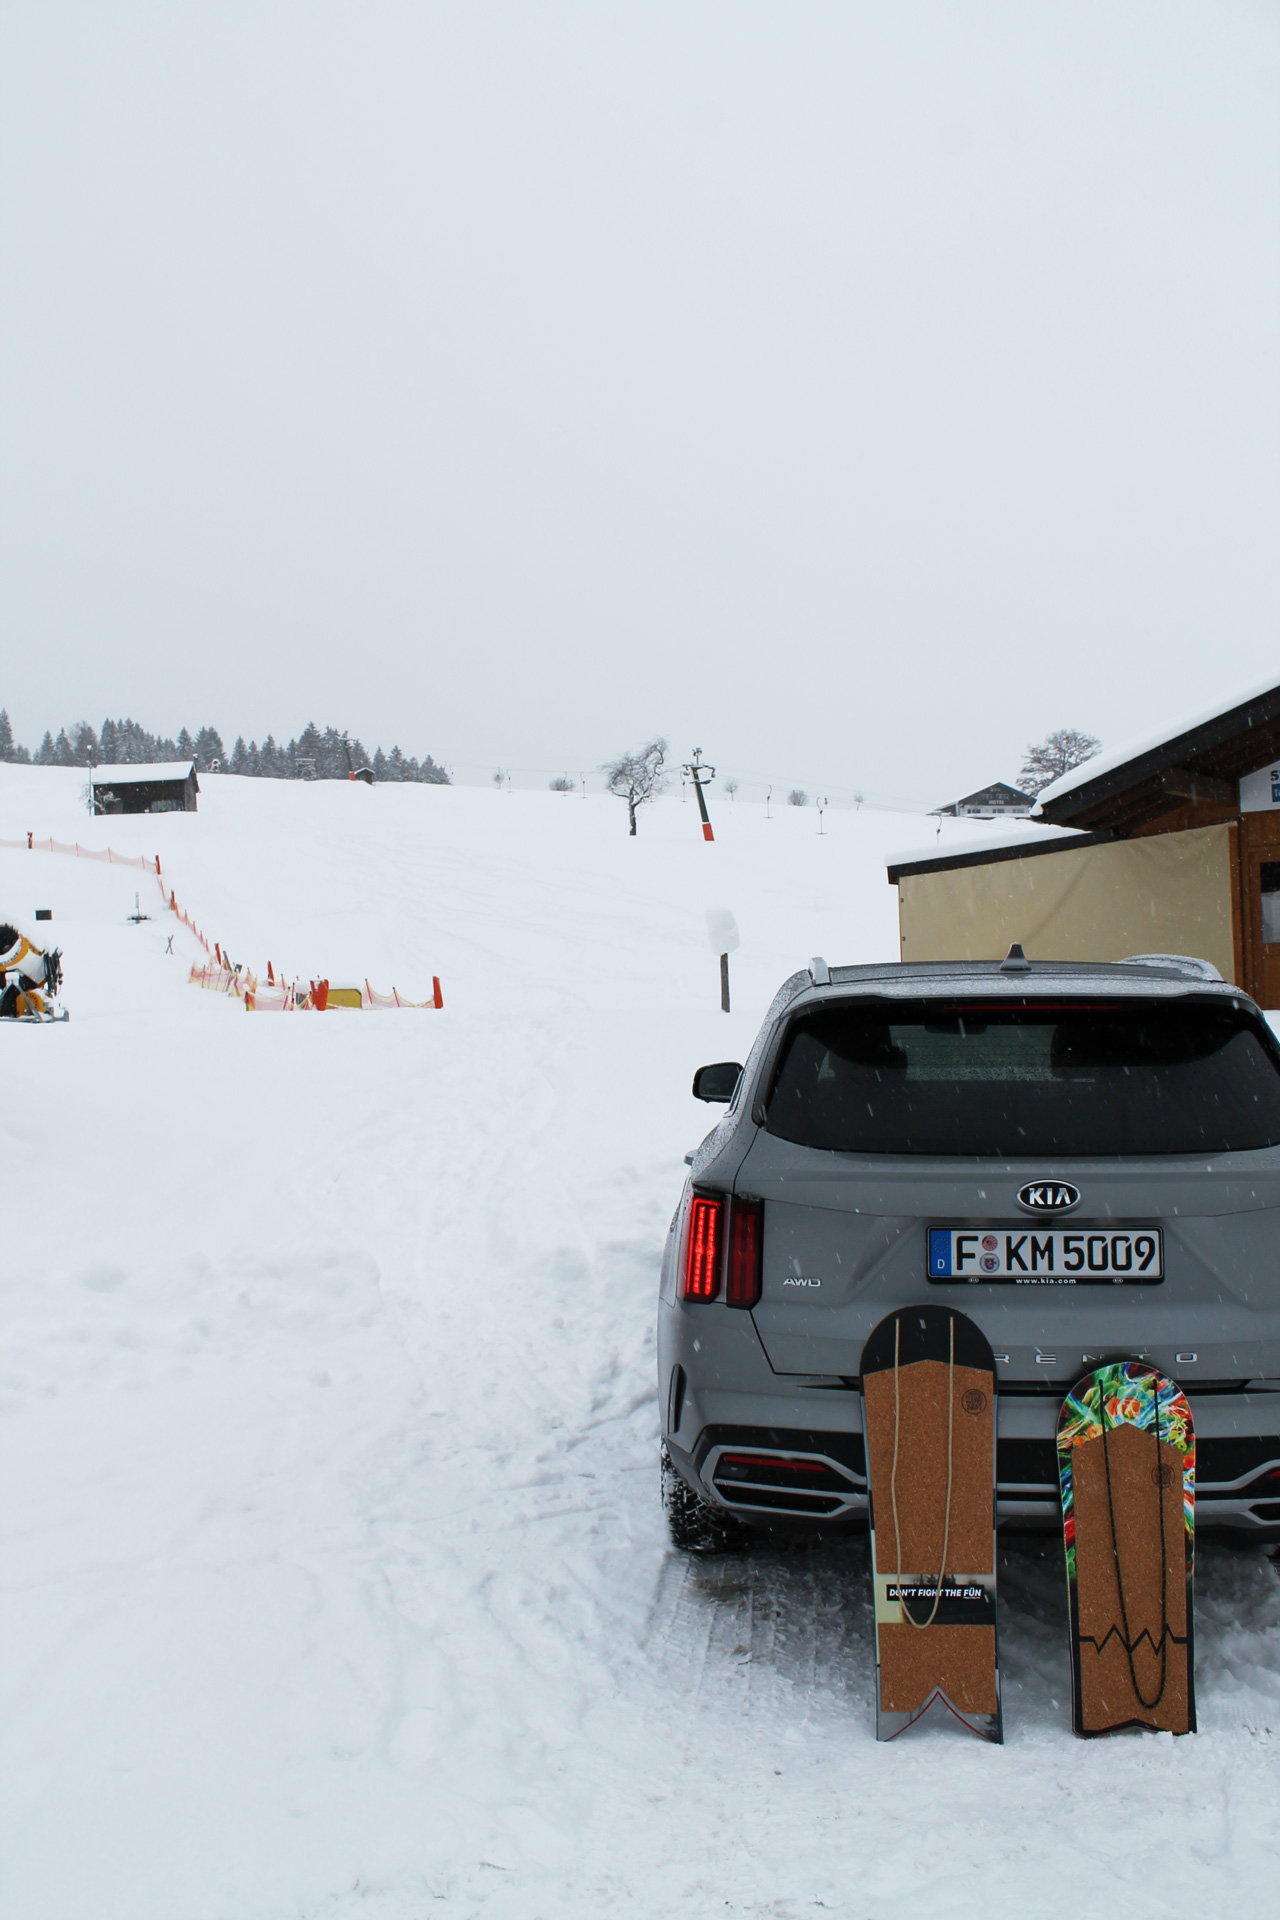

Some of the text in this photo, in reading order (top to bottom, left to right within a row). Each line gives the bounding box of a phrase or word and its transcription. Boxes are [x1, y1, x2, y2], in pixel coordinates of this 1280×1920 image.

[1270, 770, 1280, 782] S
[1029, 1187, 1072, 1205] KIA
[956, 1236, 979, 1271] F
[1063, 1235, 1156, 1271] 5009
[937, 1258, 946, 1269] D
[783, 1277, 821, 1287] AWD
[1015, 1277, 1077, 1285] www.kia.com
[994, 1352, 1198, 1364] RENTO
[889, 1587, 982, 1597] DON'T FIGHT THE FÜN
